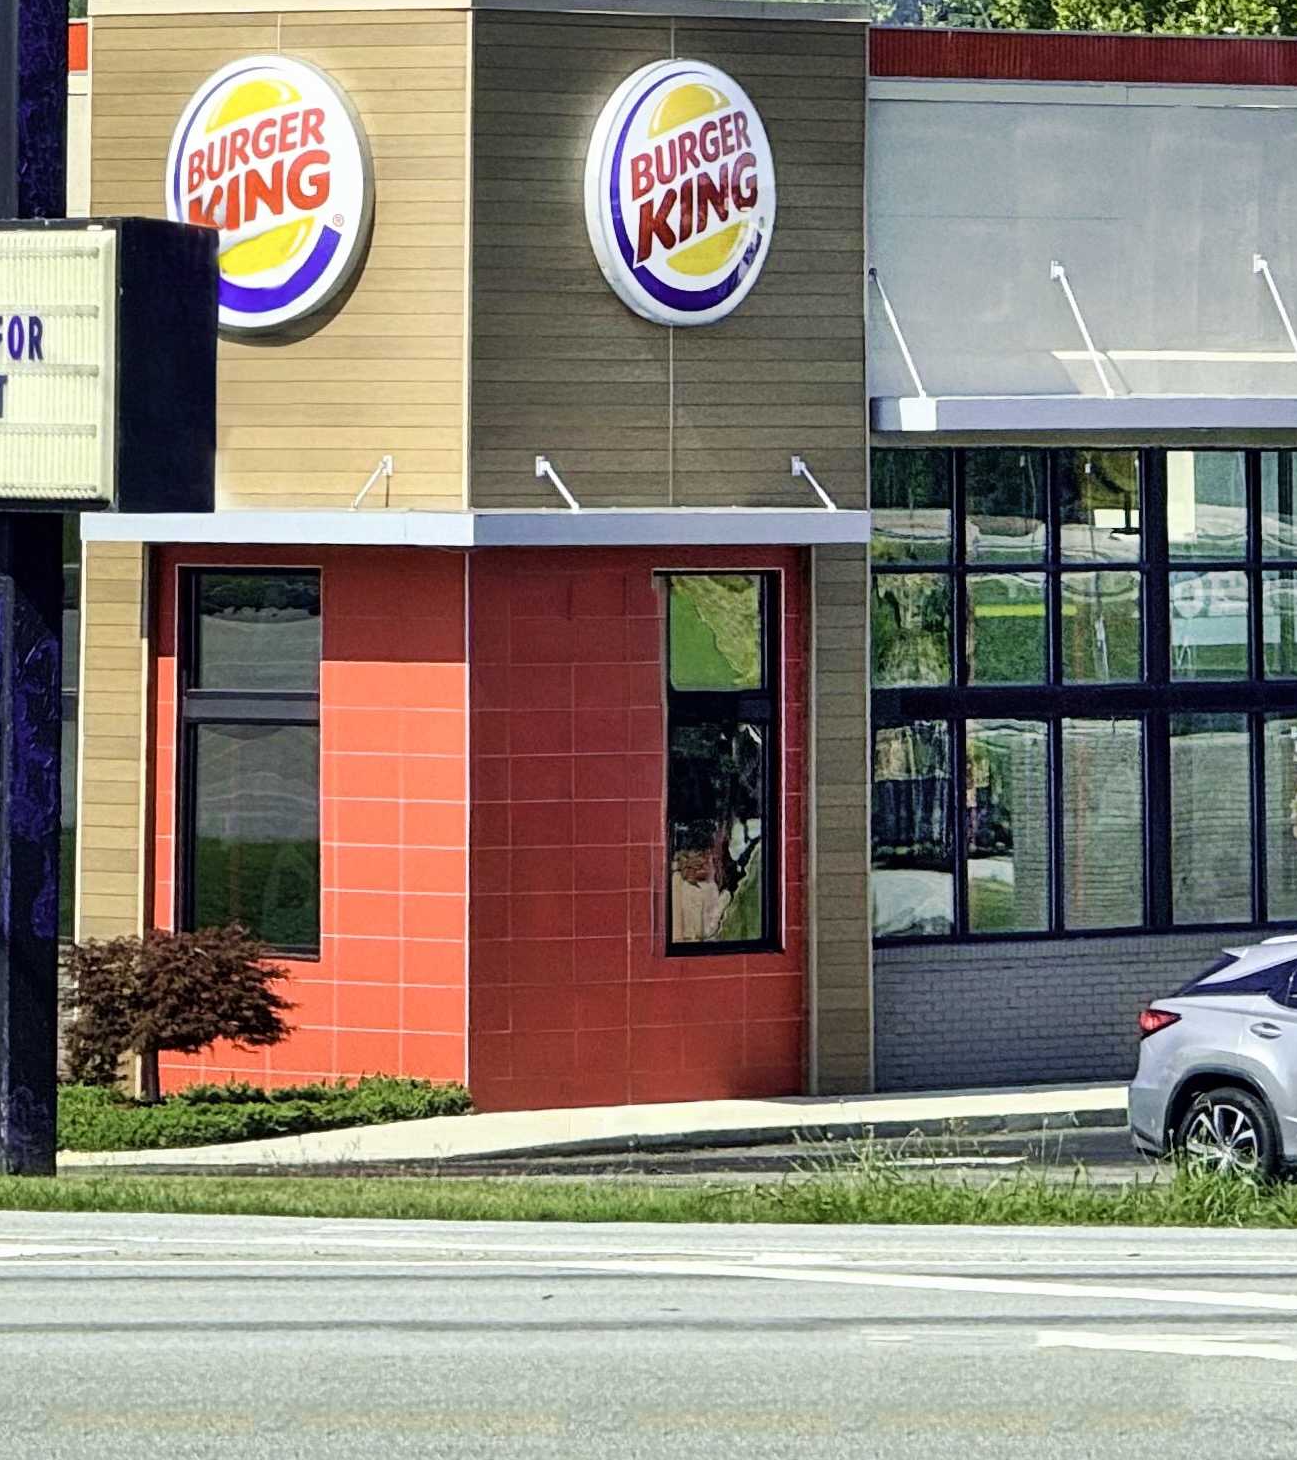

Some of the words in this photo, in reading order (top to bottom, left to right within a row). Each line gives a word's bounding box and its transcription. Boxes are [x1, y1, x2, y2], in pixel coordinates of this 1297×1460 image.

[188, 107, 326, 196] BURGER
[631, 110, 751, 202] BURGER
[637, 152, 758, 264] KING
